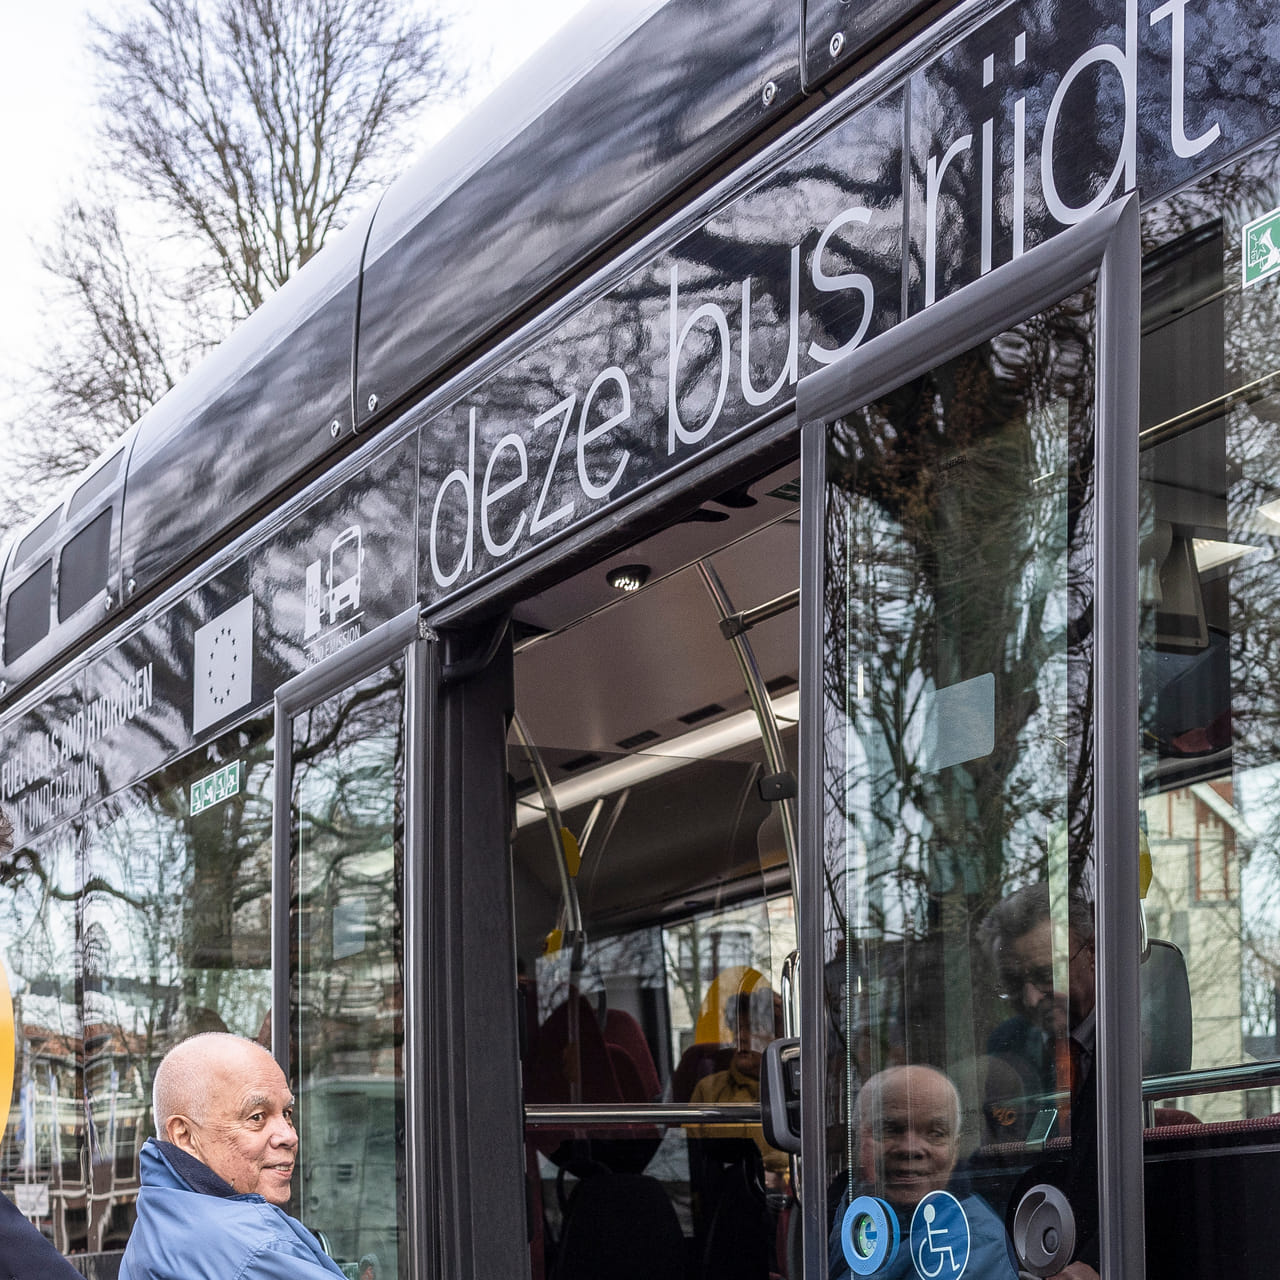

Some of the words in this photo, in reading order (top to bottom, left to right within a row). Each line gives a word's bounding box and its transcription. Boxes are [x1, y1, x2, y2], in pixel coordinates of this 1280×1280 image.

[429, 366, 632, 589] deze
[666, 205, 876, 456] bus
[1, 753, 25, 801] FUEL
[61, 711, 85, 761] AND
[86, 662, 153, 747] HYDROGEN
[29, 754, 100, 832] UNDERTAKING
